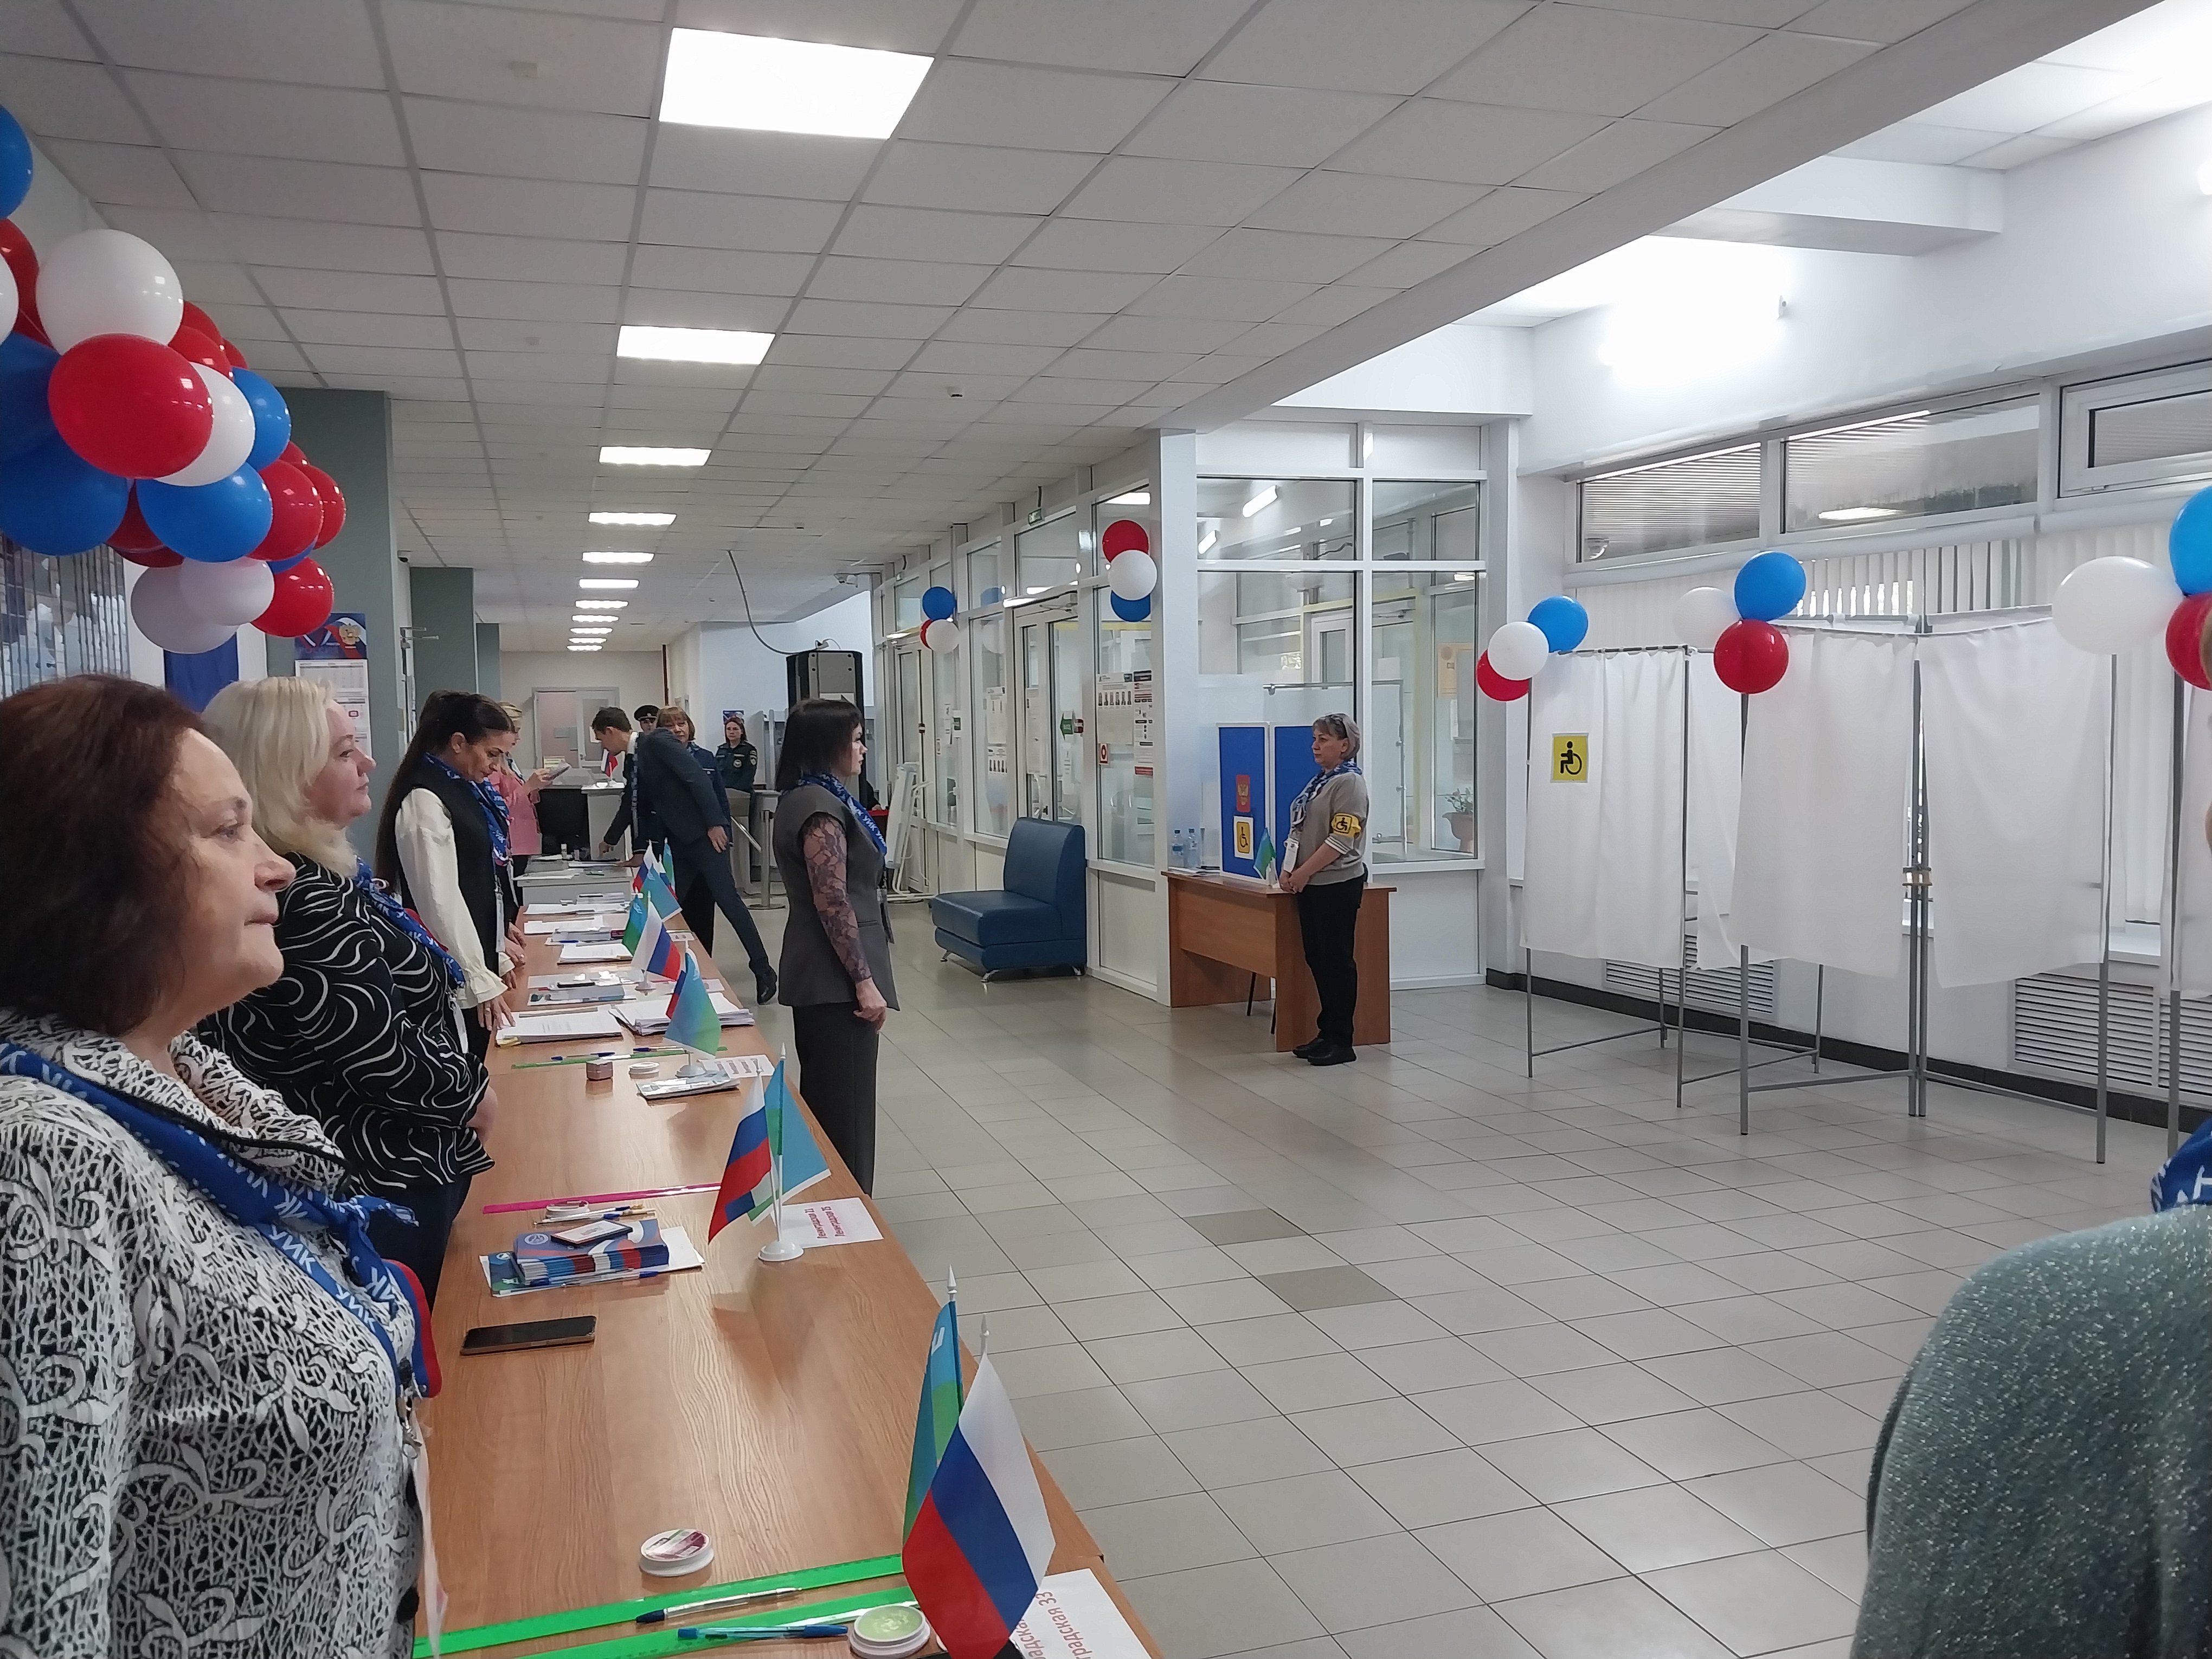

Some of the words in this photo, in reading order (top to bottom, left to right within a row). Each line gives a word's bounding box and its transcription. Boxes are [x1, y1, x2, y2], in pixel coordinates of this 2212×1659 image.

[862, 815, 878, 832] УИК
[269, 1224, 317, 1275] УИК
[335, 1283, 377, 1333] УИК
[1035, 1591, 1057, 1606] 33
